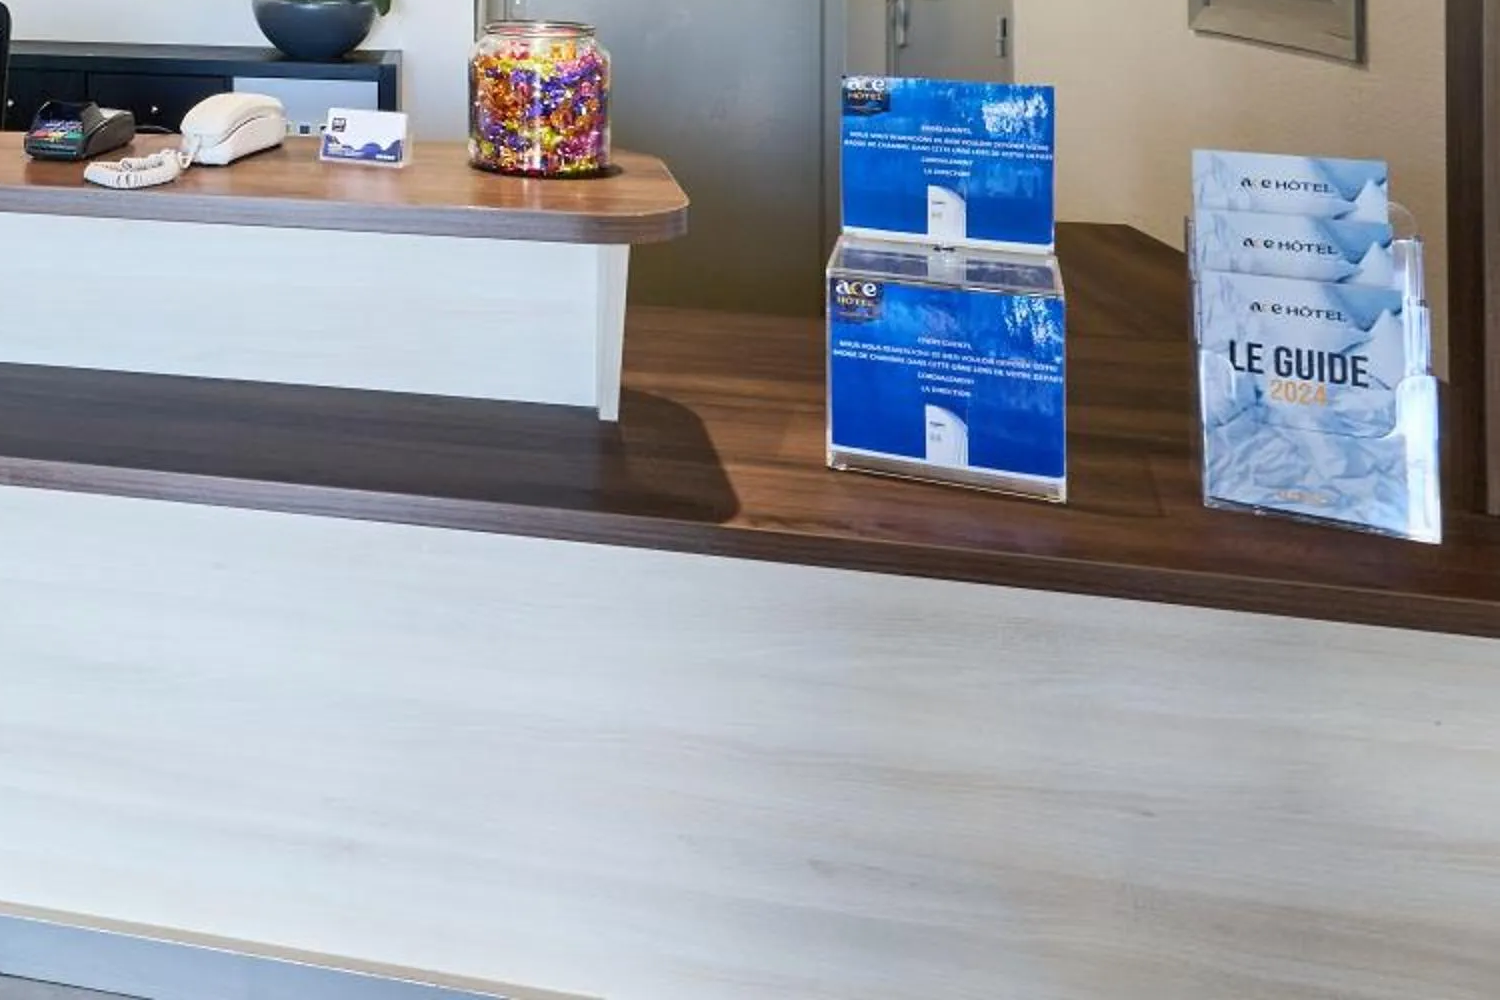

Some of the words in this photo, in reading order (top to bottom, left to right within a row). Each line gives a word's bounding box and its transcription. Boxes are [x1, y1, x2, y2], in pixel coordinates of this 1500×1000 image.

[835, 279, 877, 297] ace
[1229, 340, 1264, 374] LE
[1274, 345, 1369, 388] GUIDE
[1270, 379, 1328, 406] 2024
